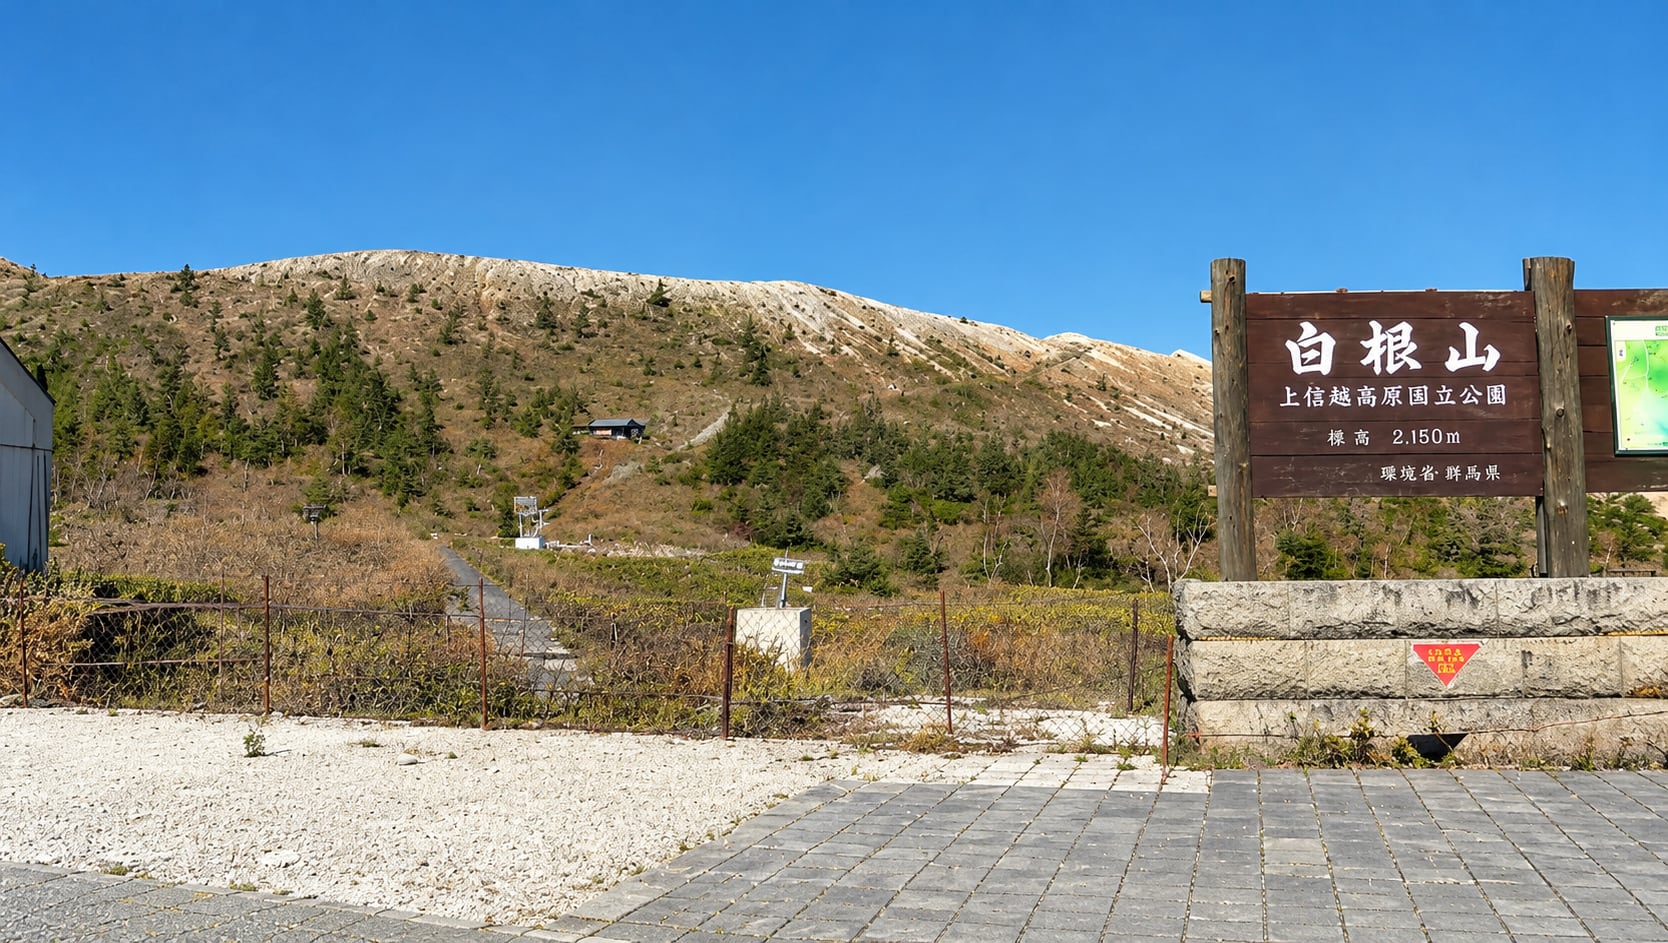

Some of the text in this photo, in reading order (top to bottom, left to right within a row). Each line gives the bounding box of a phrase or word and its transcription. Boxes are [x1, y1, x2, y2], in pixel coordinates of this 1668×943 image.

[1284, 319, 1501, 376] 白根山
[1279, 384, 1506, 408] 上信越高原国立公園
